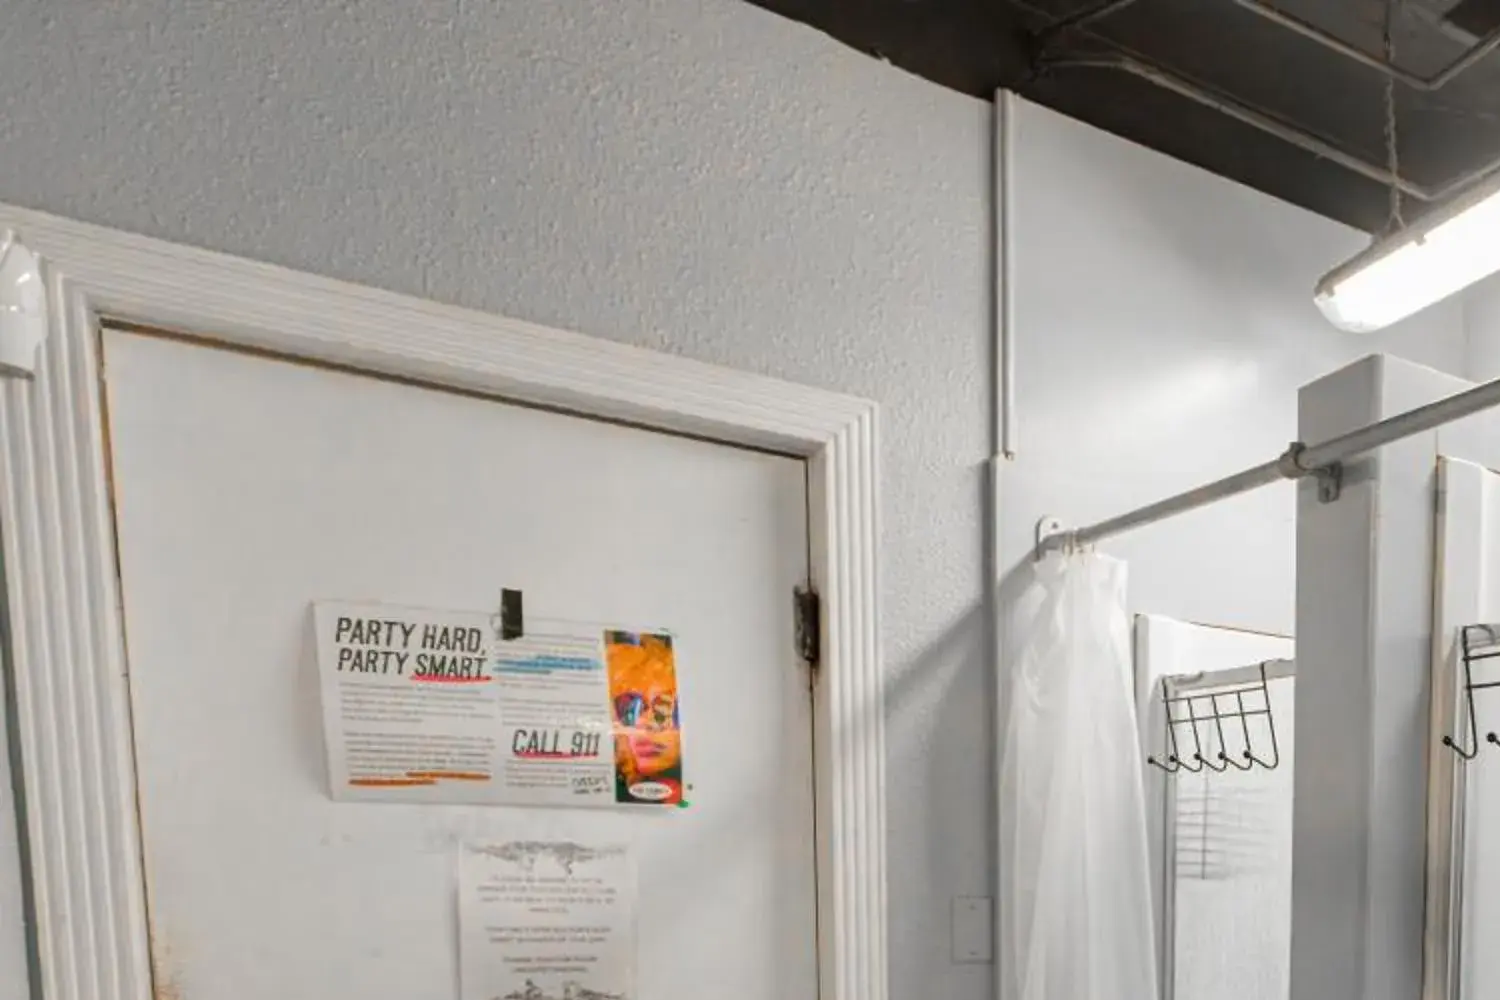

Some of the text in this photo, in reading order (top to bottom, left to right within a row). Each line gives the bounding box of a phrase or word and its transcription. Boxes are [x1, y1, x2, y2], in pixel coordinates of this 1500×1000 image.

[335, 617, 487, 655] PARTY HARD,
[337, 648, 409, 673] PARTY
[512, 728, 601, 757] CALL 911
